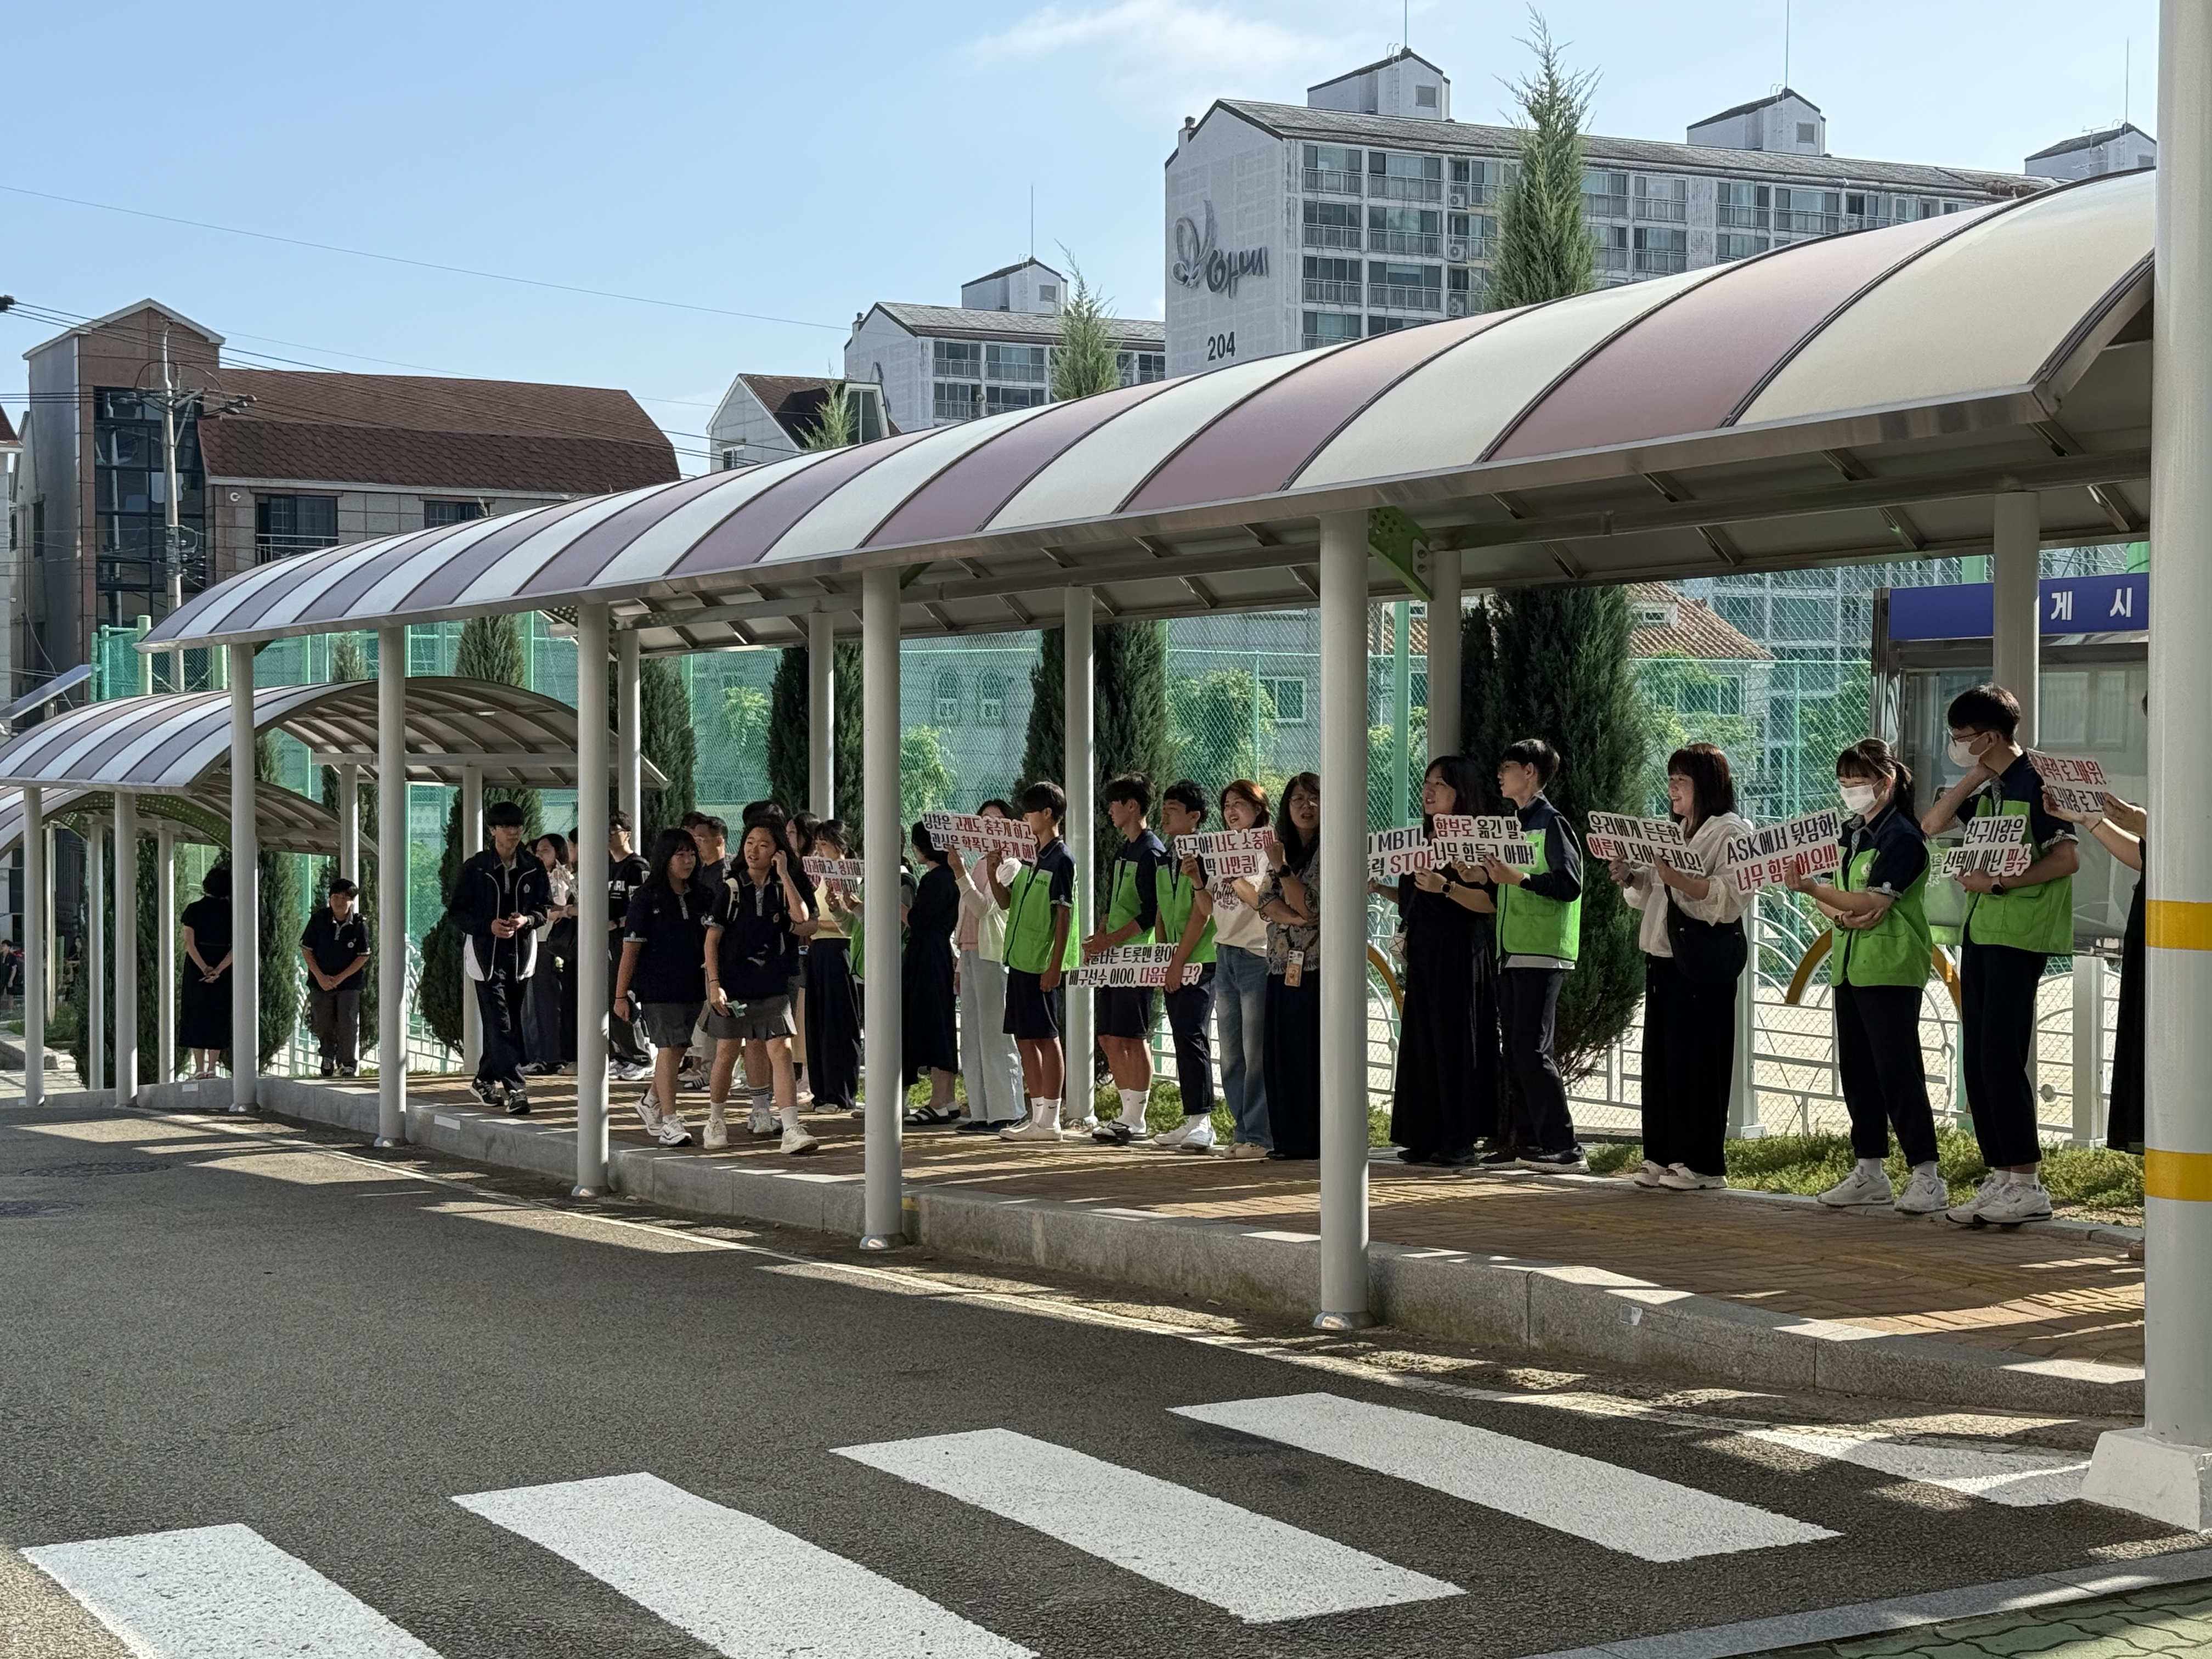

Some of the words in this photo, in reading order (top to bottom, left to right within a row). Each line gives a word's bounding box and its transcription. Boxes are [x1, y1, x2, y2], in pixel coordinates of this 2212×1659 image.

[1207, 331, 1235, 362] 204
[2051, 591, 2073, 620] 게
[2109, 587, 2132, 617] 시
[2058, 759, 2107, 785] 로그아웃!
[923, 813, 951, 831] 칭찬은
[954, 816, 982, 833] 고래도
[984, 819, 1012, 837] 춤추게
[1014, 823, 1036, 842] 하고,
[1378, 827, 1425, 851] MBTI,
[1435, 817, 1475, 837] 함부로
[1477, 819, 1503, 839] 옮긴
[1506, 820, 1525, 840] 말,
[1590, 815, 1643, 839] 우리에게
[1643, 821, 1684, 845] 든든한
[1728, 827, 1788, 865] ASK에서
[1791, 812, 1839, 847] 뒷담화!
[1965, 819, 2024, 844] 친구사랑은
[932, 833, 960, 850] 관심은
[961, 836, 990, 853] 학폭도
[1022, 843, 1035, 860] 해!
[1176, 836, 1214, 856] 친구야!
[1215, 833, 1239, 852] 너도
[1242, 830, 1274, 850] 소중해
[1434, 840, 1458, 861] 너무
[1462, 842, 1500, 862] 힘들고
[1504, 845, 1534, 865] 아파!
[1589, 837, 1629, 860] 어른이
[1629, 842, 1654, 864] 되어
[1657, 847, 1703, 873] 주세요!
[1205, 858, 1216, 876] 딱
[1219, 855, 1257, 874] 나만큼!
[1368, 857, 1385, 878] 력
[1943, 849, 1979, 874] 선택이
[1979, 849, 2004, 872] 아닌
[2004, 848, 2028, 872] 필수
[1736, 864, 1765, 891] 너무
[1121, 946, 1152, 963] 트롯맨
[1069, 968, 1108, 986] 배구선수
[1182, 966, 1200, 983] 구?
